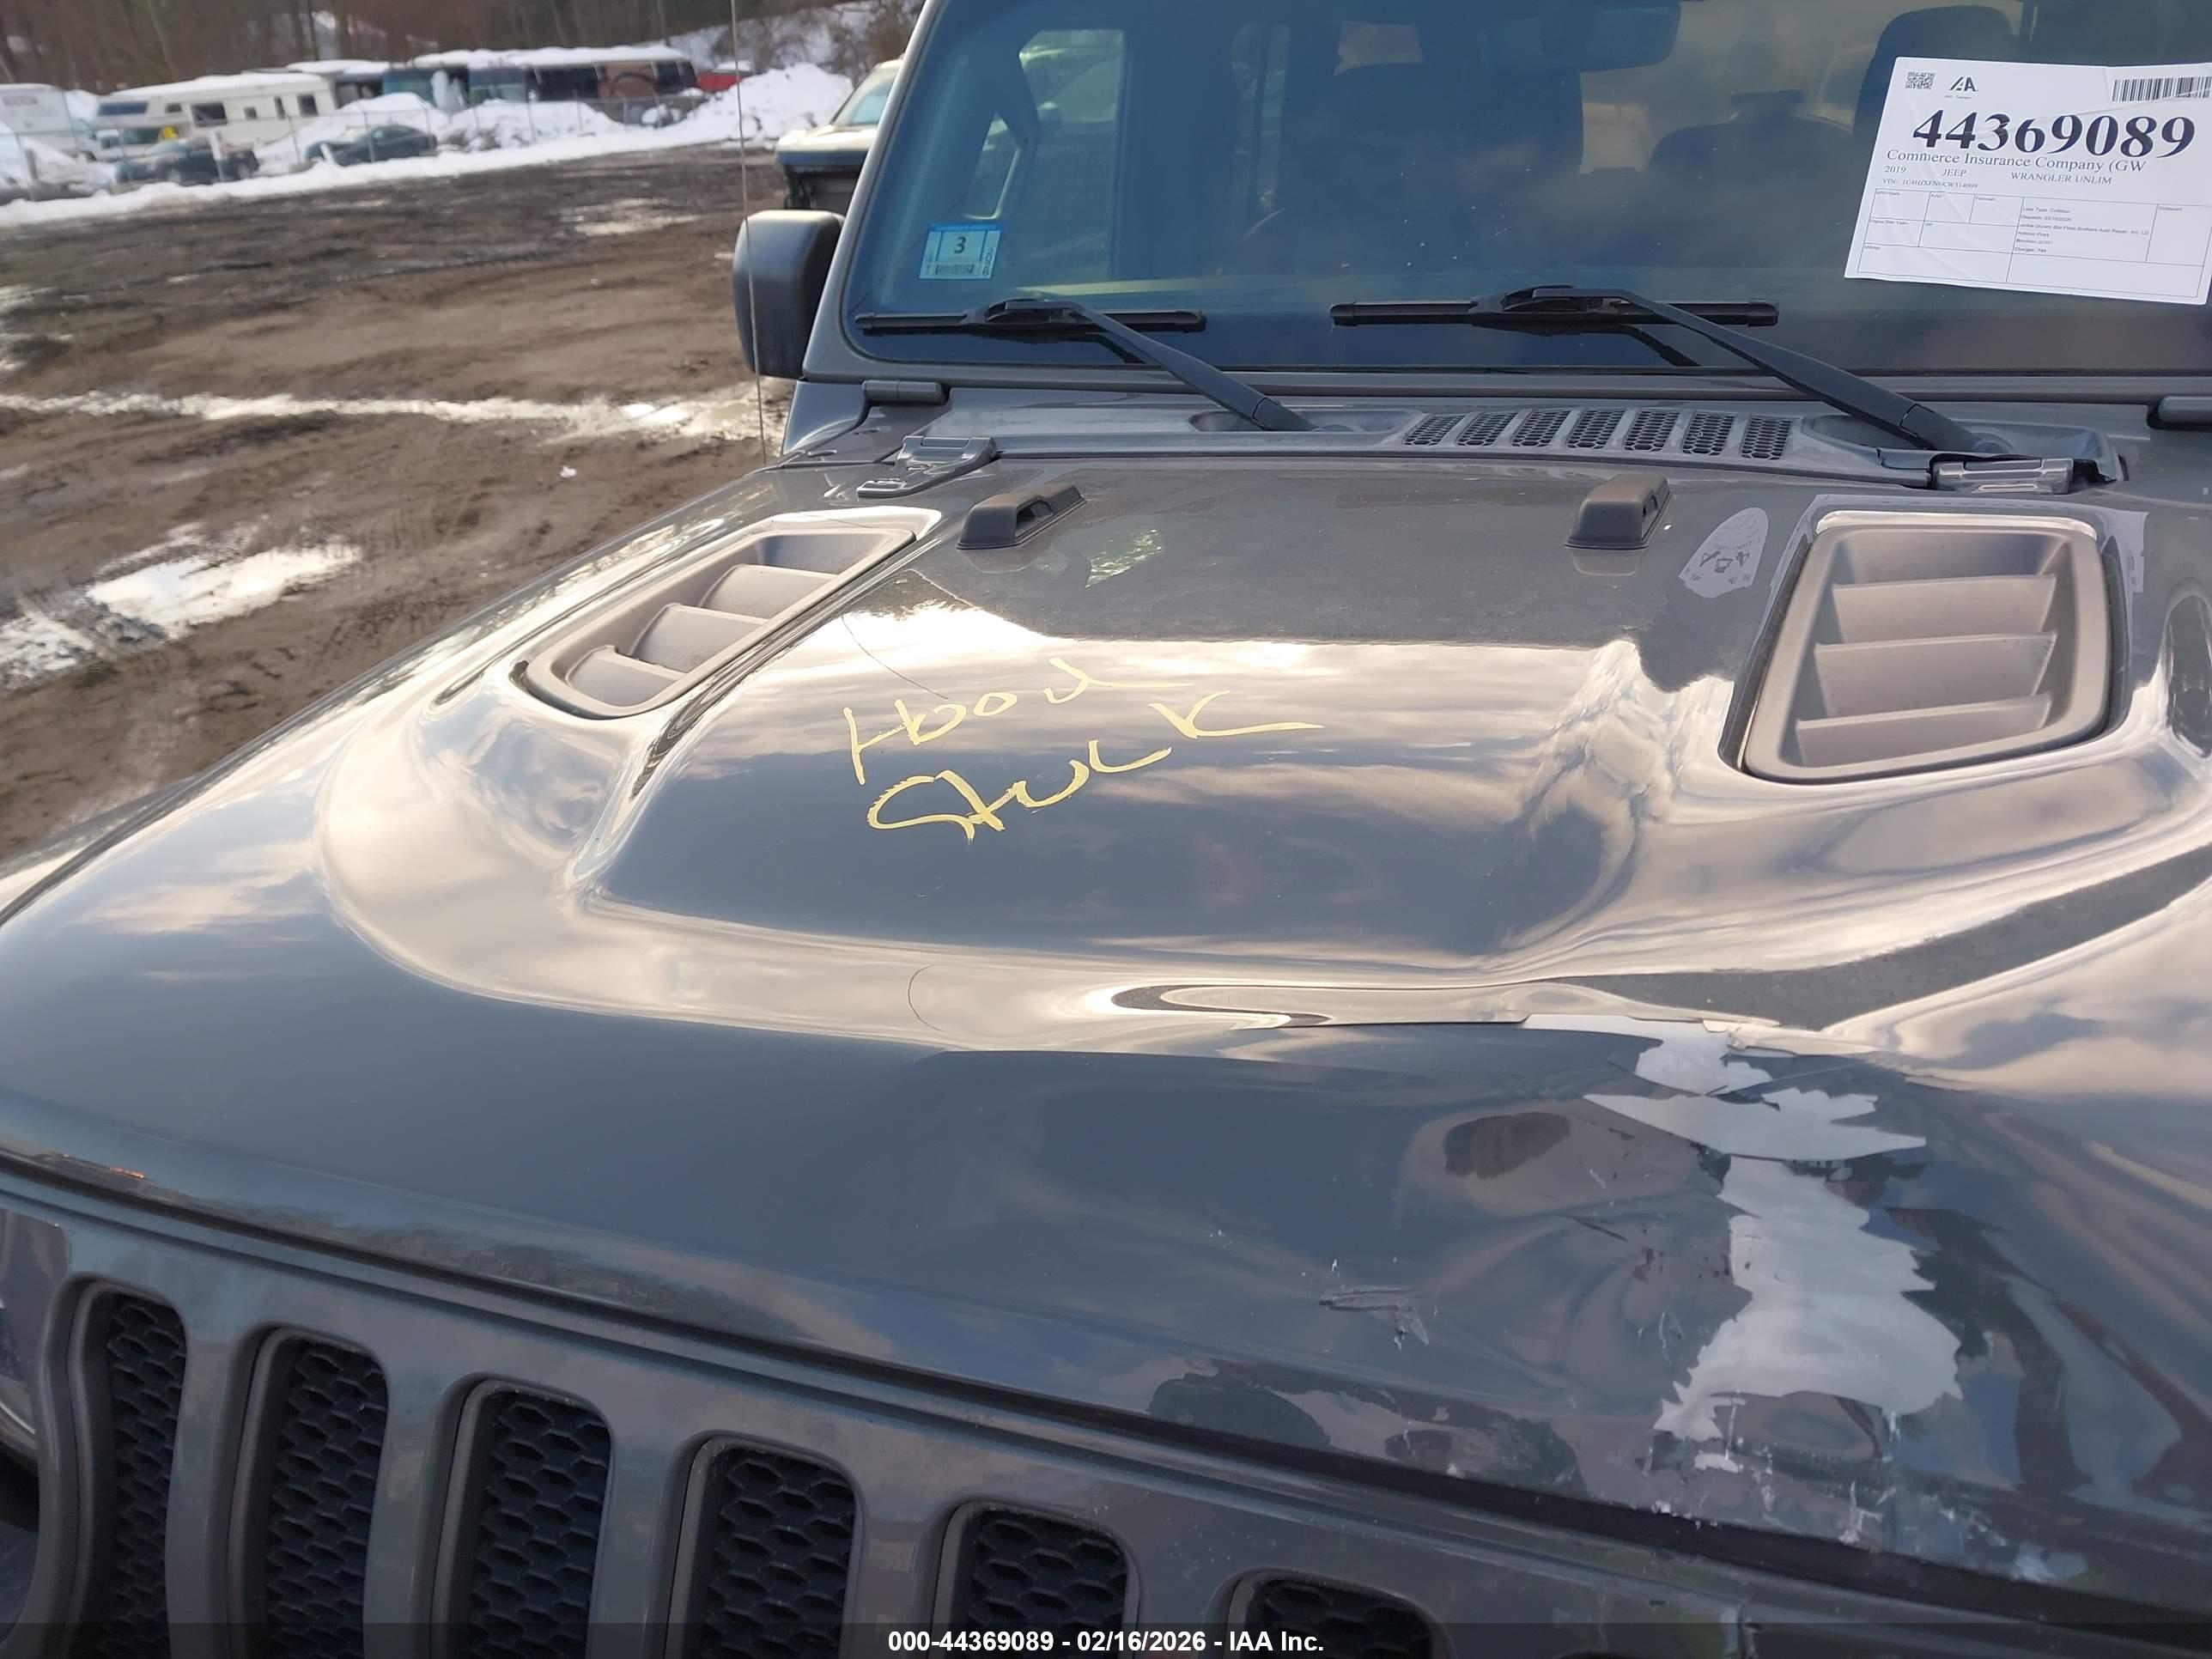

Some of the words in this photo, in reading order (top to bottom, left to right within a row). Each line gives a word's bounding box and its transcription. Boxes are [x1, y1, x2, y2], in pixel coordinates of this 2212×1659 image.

[1912, 109, 2196, 159] 44369089
[1887, 149, 1960, 163] Commerce
[1965, 152, 2031, 167] Insurance
[2035, 156, 2104, 173] Company
[2108, 159, 2147, 173] (GW
[1884, 165, 1906, 173] 2019
[1942, 168, 1967, 177] JEEP
[2011, 171, 2071, 183] WRANGLER
[2075, 174, 2112, 185] UNLIM
[954, 236, 967, 254] 3
